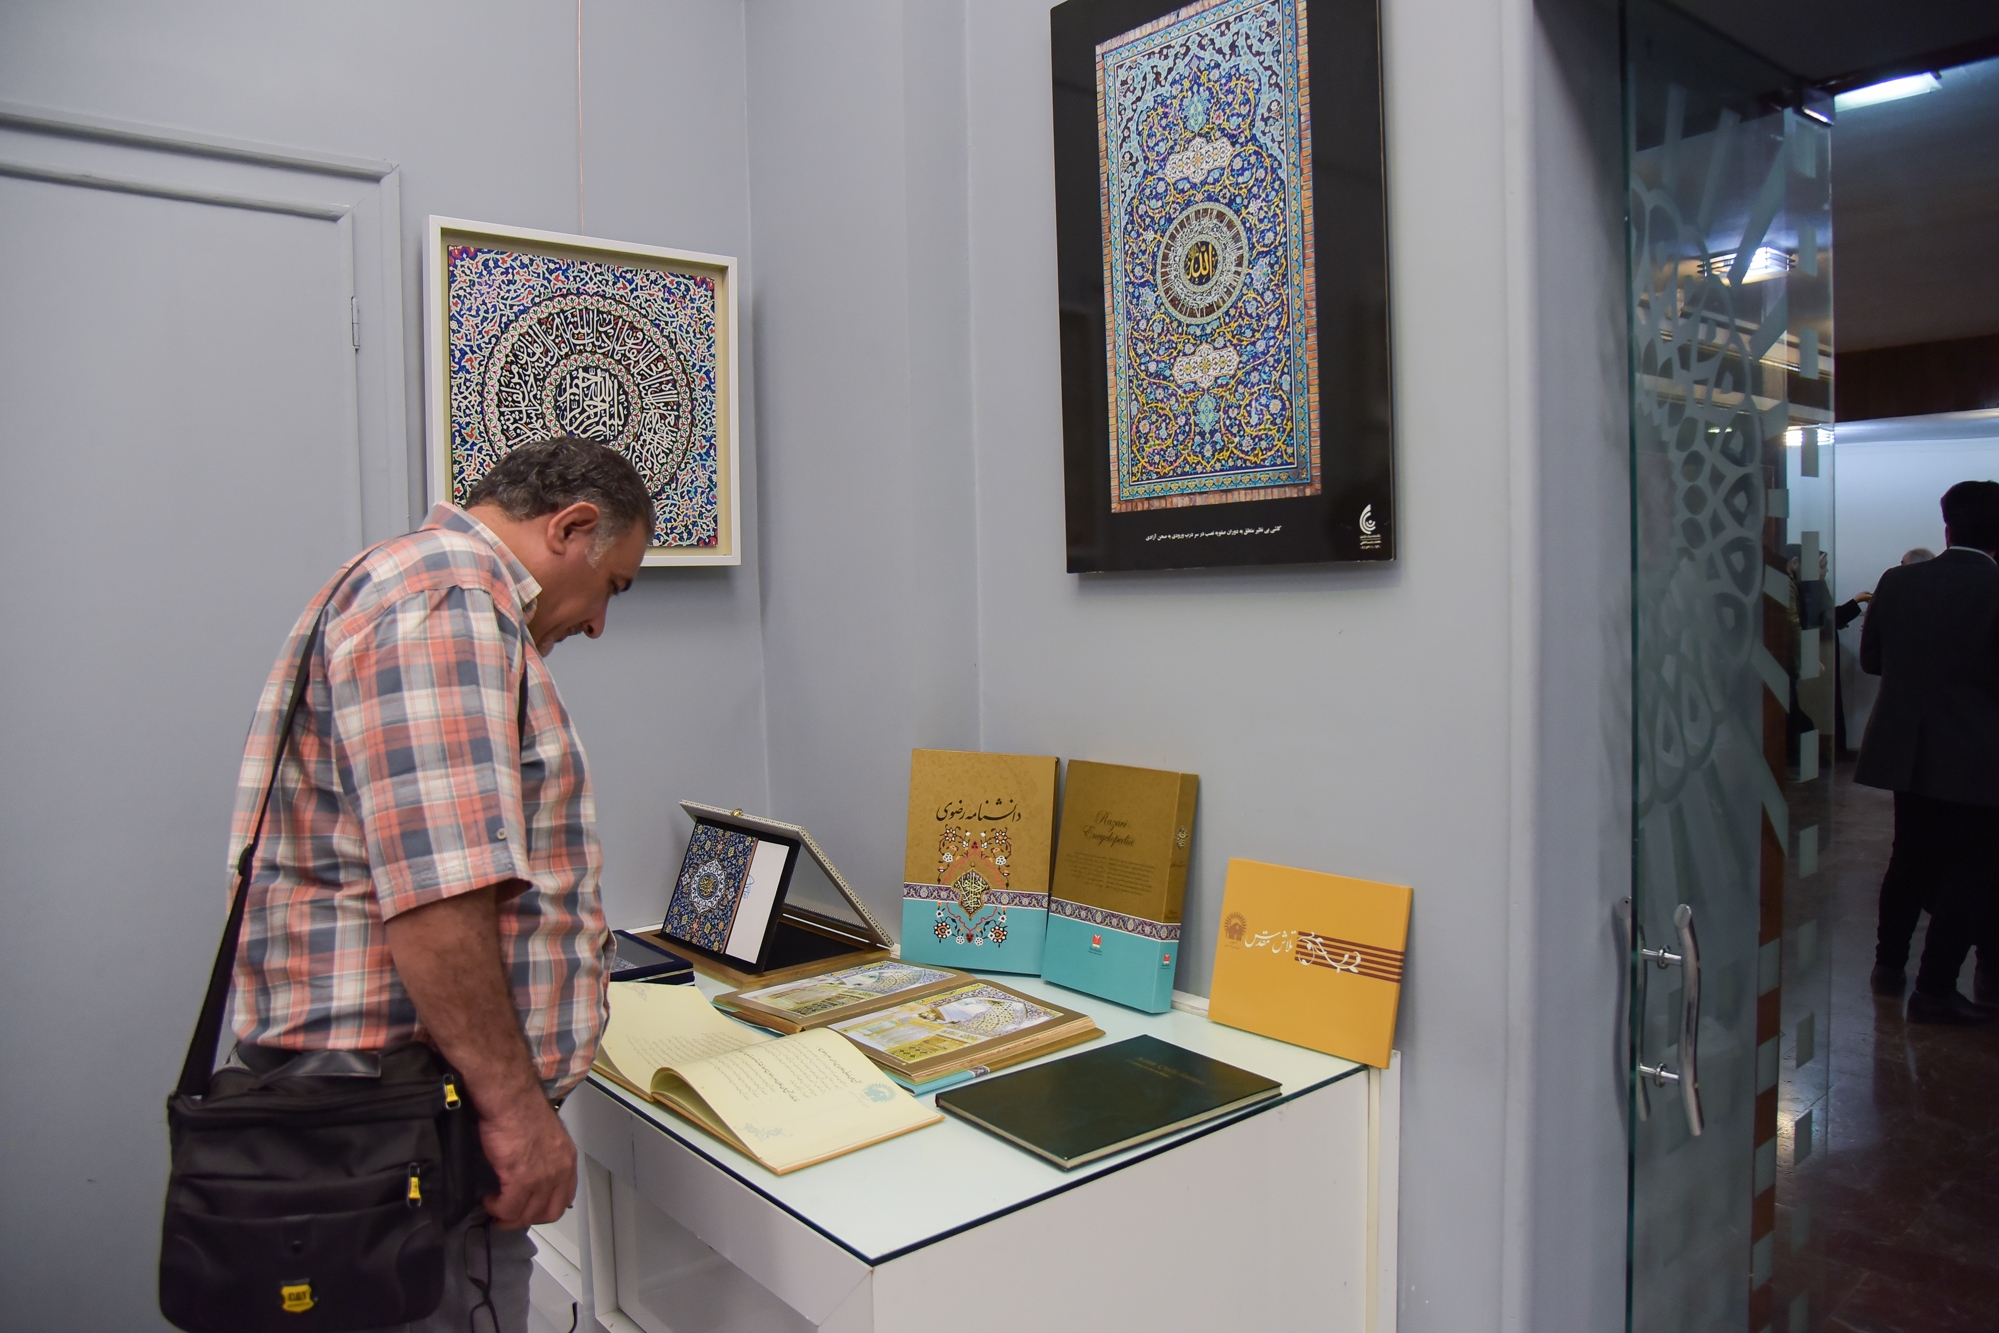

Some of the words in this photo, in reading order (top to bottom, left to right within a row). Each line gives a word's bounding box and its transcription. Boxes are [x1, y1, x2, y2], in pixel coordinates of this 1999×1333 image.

[936, 799, 966, 821] رضوی
[965, 798, 1022, 822] دانشنامه
[1271, 930, 1297, 954] تلاش
